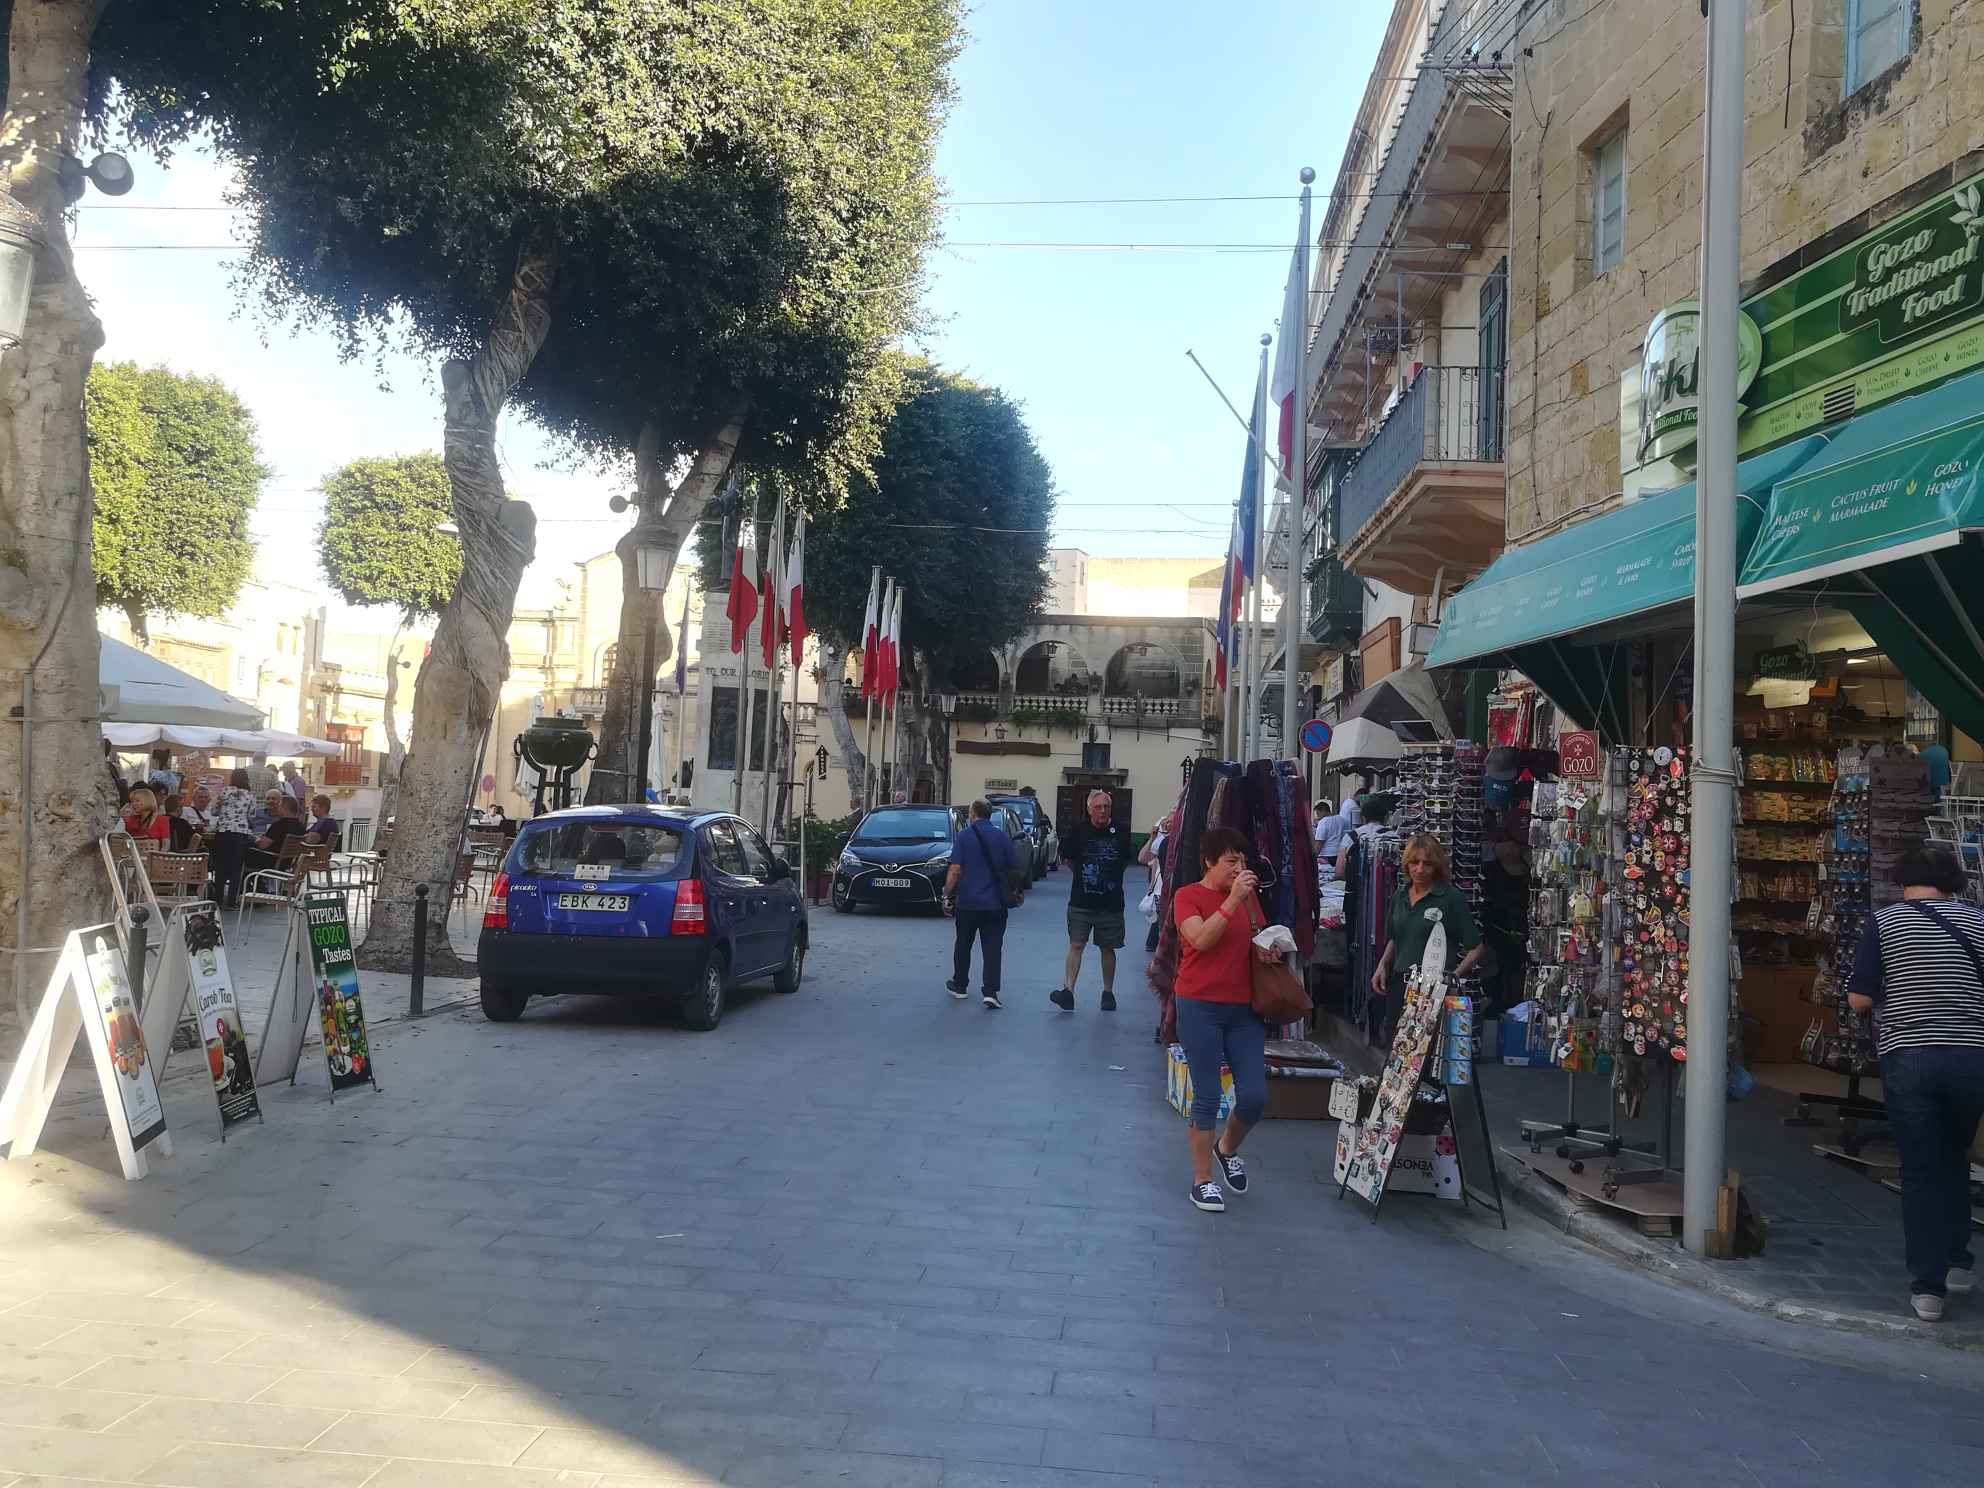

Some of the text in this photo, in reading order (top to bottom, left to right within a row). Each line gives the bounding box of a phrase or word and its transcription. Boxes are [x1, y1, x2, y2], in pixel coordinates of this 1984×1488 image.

[1867, 229, 1937, 283] Gozo
[1846, 235, 1979, 317] Traditional
[1901, 273, 1967, 323] Food
[1831, 479, 1901, 508] CACTUS FRUIT
[1829, 497, 1889, 523] MARMALADE
[1907, 719, 1937, 736] DRINK
[1563, 755, 1594, 773] GOZO
[560, 894, 628, 910] EBK 423
[308, 907, 345, 925] TYPICAL
[314, 925, 345, 945] GOZO
[322, 946, 352, 964] Tastes
[199, 989, 218, 1011] Carob
[218, 988, 232, 1004] Tea
